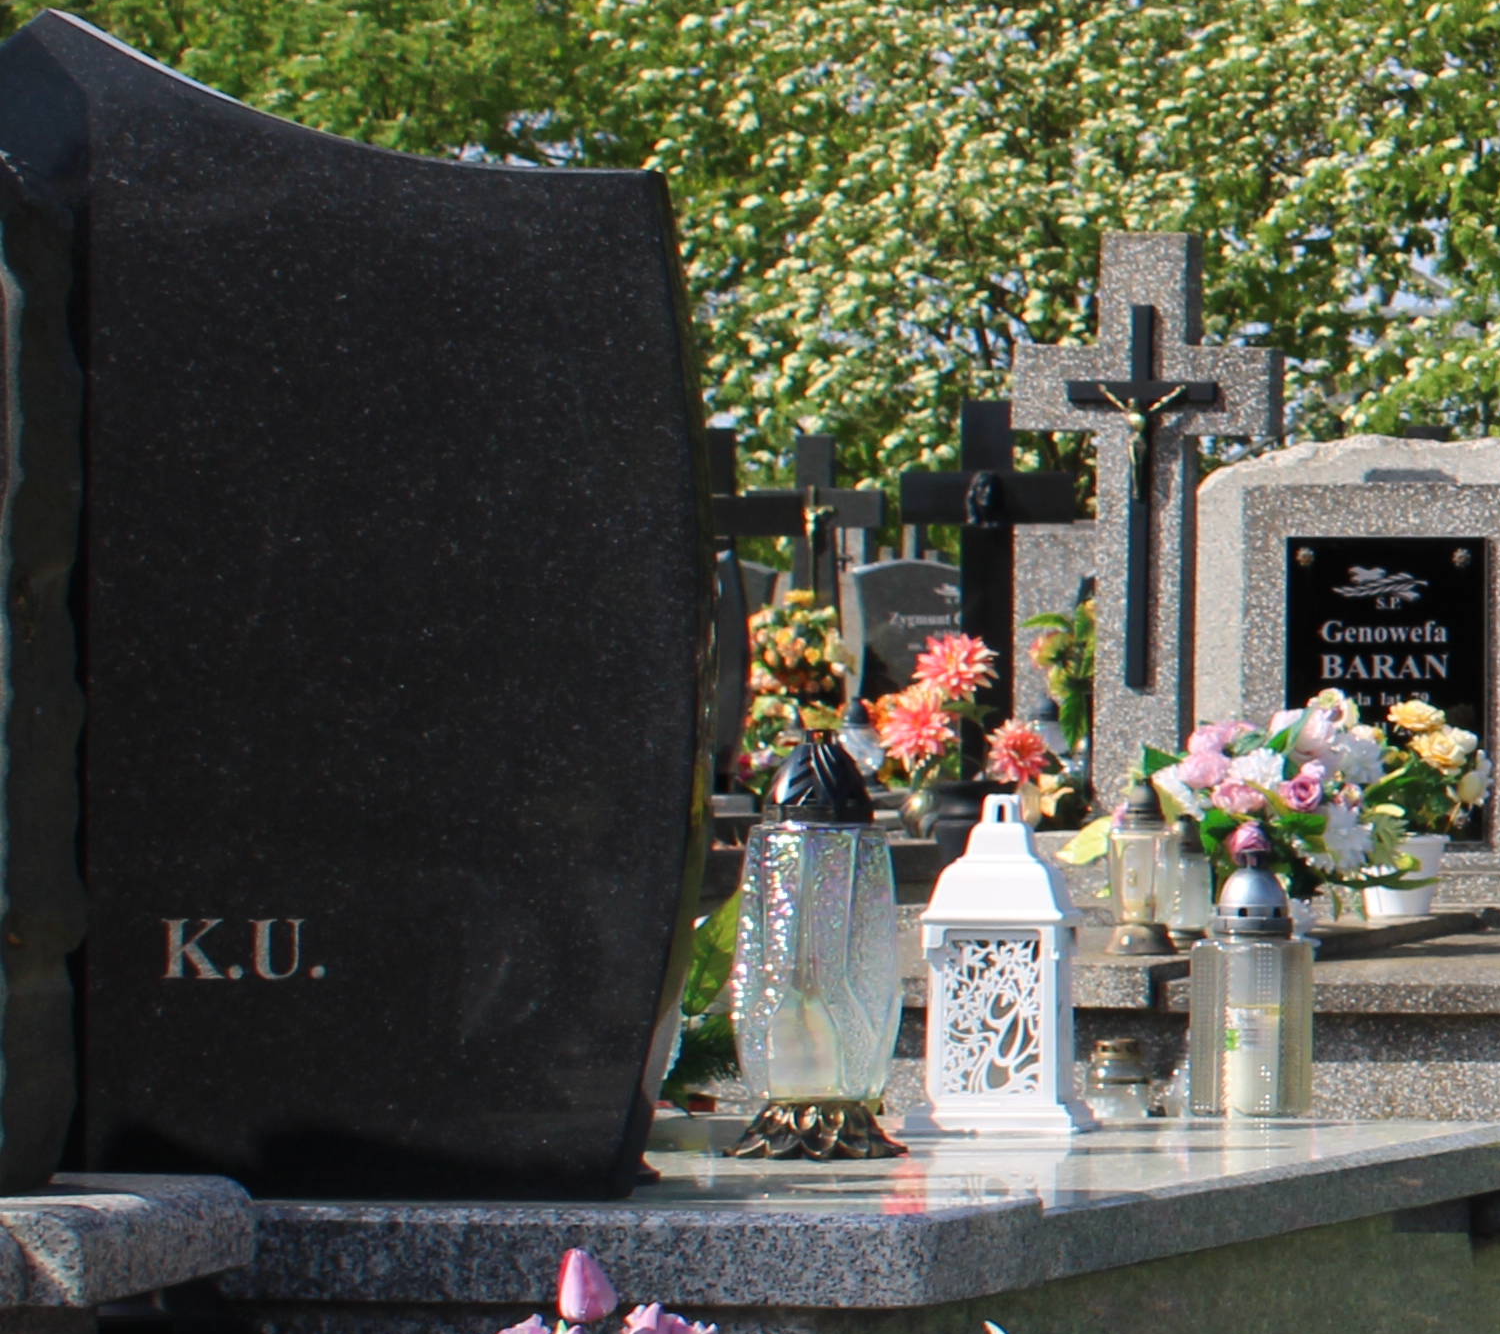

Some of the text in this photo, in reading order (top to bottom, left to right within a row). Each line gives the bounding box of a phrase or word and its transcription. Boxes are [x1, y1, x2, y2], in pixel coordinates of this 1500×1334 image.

[1319, 620, 1448, 644] Genowefa
[1320, 654, 1449, 679] BARAN
[160, 918, 327, 980] K.U.
